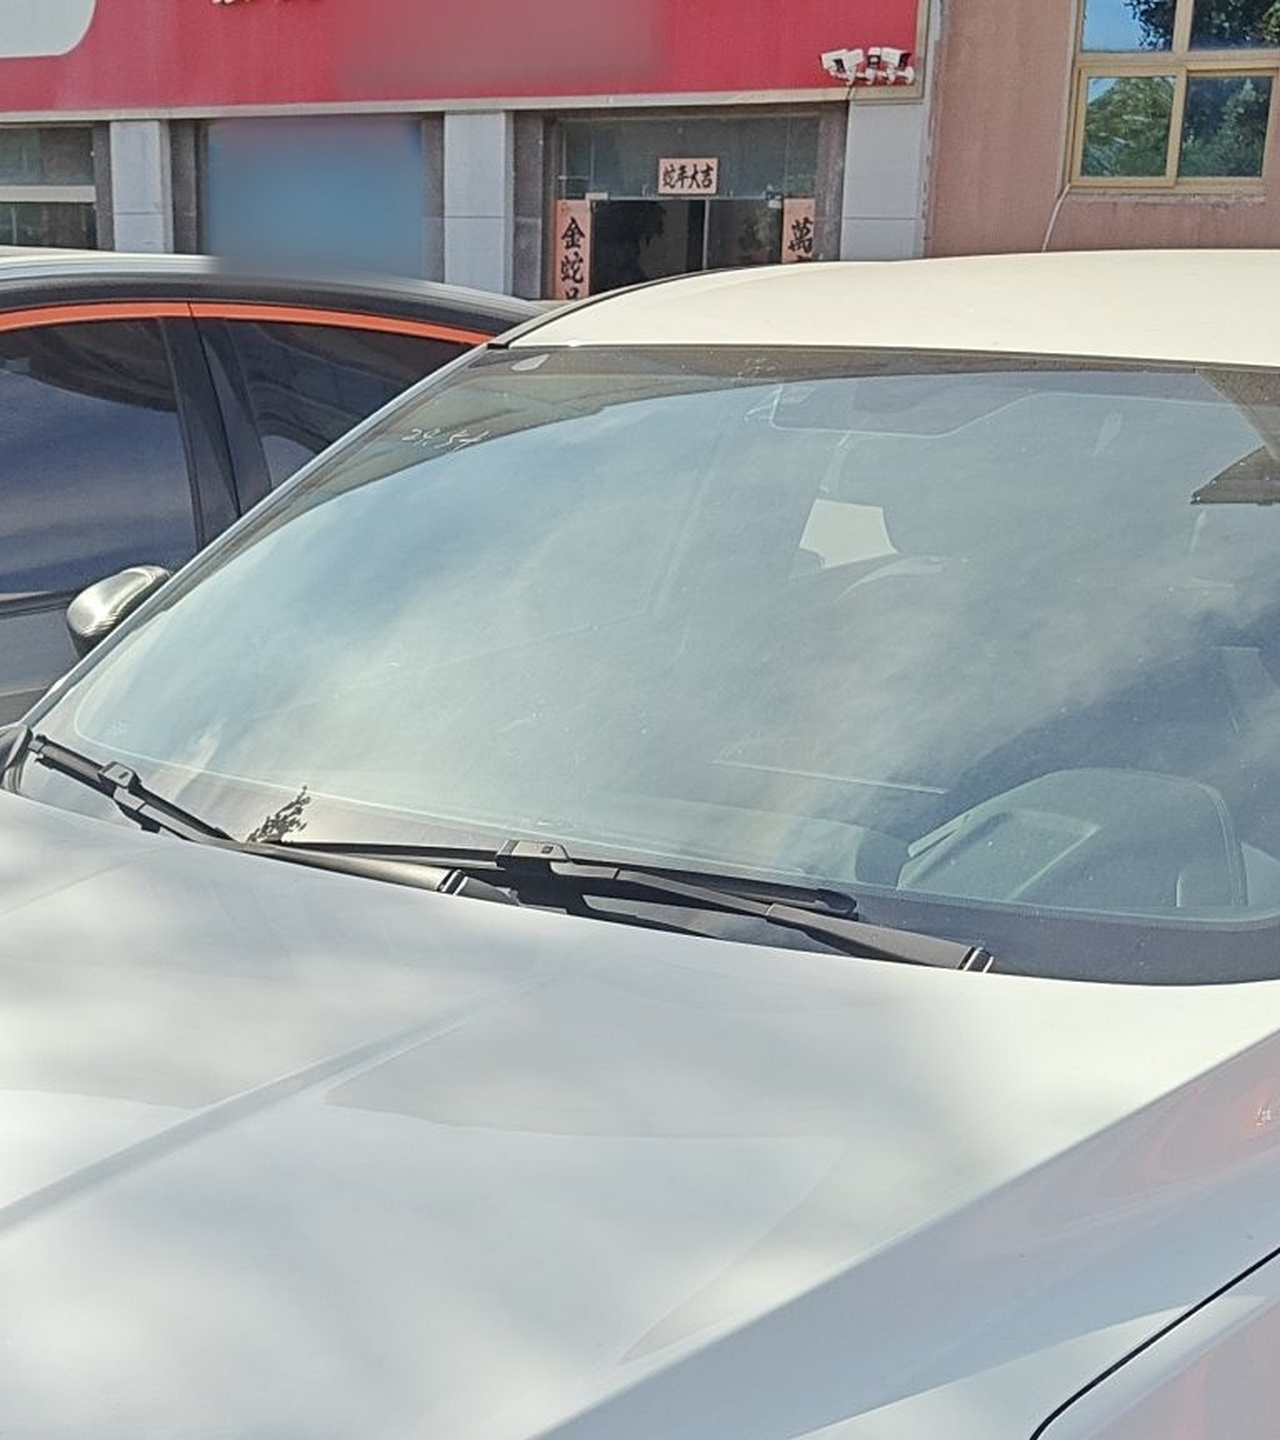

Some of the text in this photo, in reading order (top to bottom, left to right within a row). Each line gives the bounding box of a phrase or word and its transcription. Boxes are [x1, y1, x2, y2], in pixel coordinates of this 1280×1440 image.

[663, 163, 715, 189] 蛇年大吉
[788, 217, 814, 262] 萬
